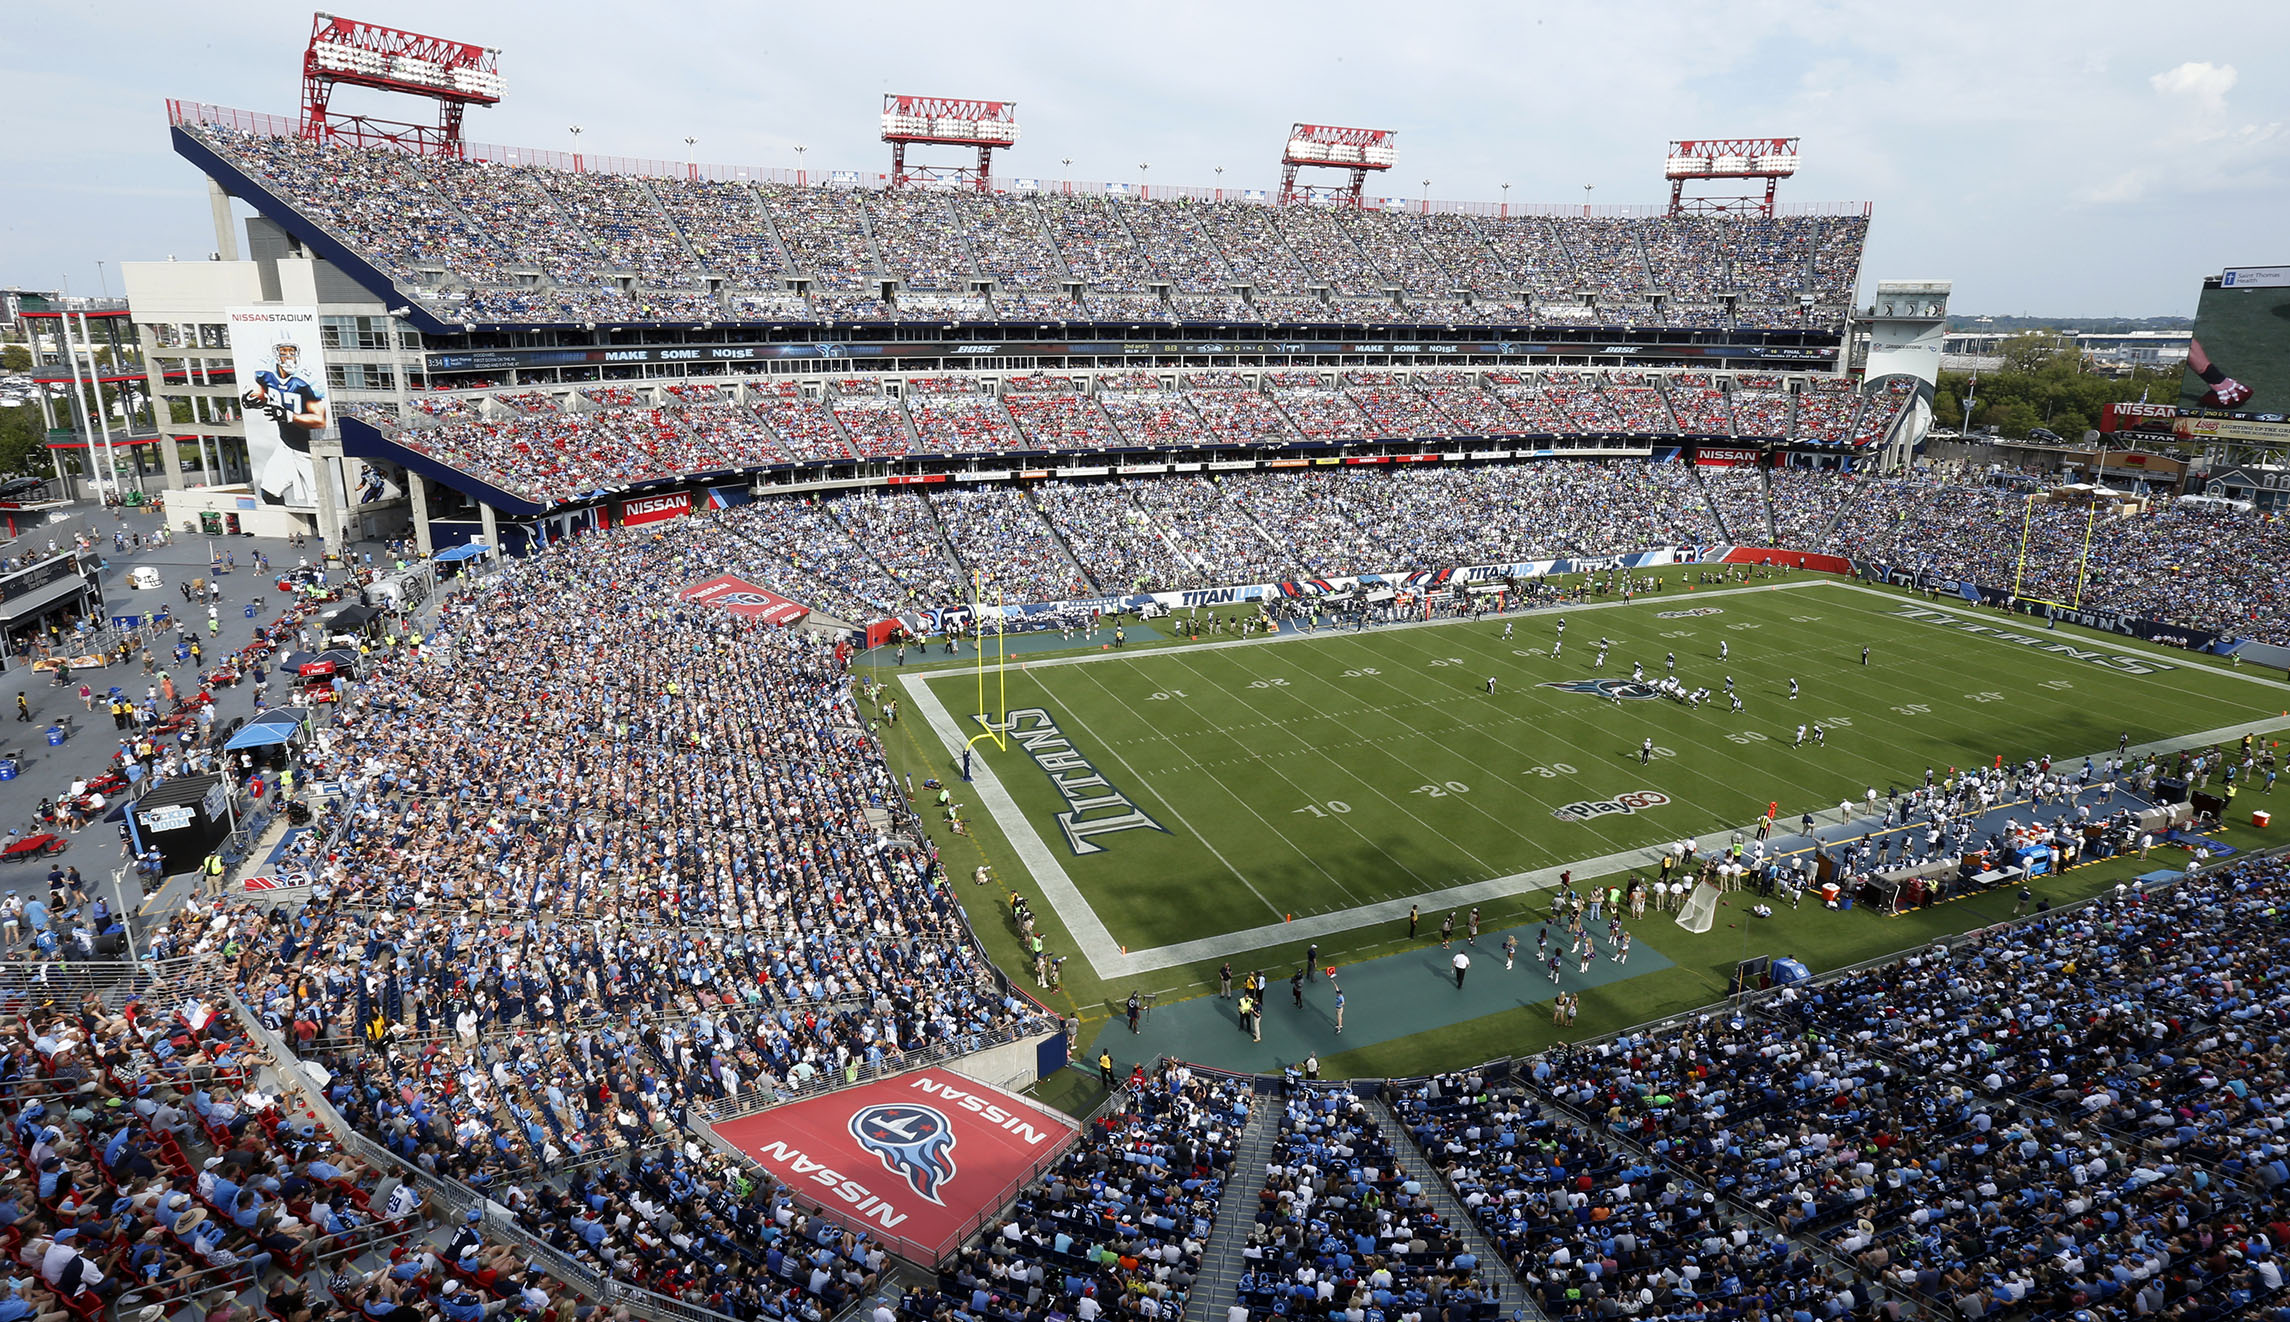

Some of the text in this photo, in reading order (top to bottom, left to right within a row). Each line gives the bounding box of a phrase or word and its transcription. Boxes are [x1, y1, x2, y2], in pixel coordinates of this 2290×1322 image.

[605, 349, 754, 360] MAKE SOME NOISE
[950, 345, 1002, 353] BOSE
[1429, 345, 1457, 353] NOISE
[428, 359, 442, 367] 3:34
[2136, 434, 2175, 442] TITAN
[1700, 450, 1756, 460] NISSAN
[626, 496, 687, 516] NISSAN
[1890, 604, 2178, 675] TITANS
[1431, 657, 1465, 667] 40
[1344, 667, 1381, 678] 30
[1252, 678, 1291, 690] 20
[2038, 680, 2070, 690] 10
[1151, 690, 1189, 701] 10
[1964, 691, 2000, 703] 20
[1890, 704, 1924, 716] 30
[1813, 717, 1849, 730] 40
[1723, 731, 1768, 745] 50
[1531, 762, 1578, 778] 30
[970, 708, 1170, 856] TITANS
[1419, 781, 1470, 798] 20
[1302, 801, 1352, 818] 10
[142, 808, 194, 824] LCKER
[152, 819, 188, 831] ROOM
[910, 1077, 1047, 1145] NISSAN
[760, 1140, 908, 1229] NISSAN
[1047, 1294, 1055, 1308] 7
